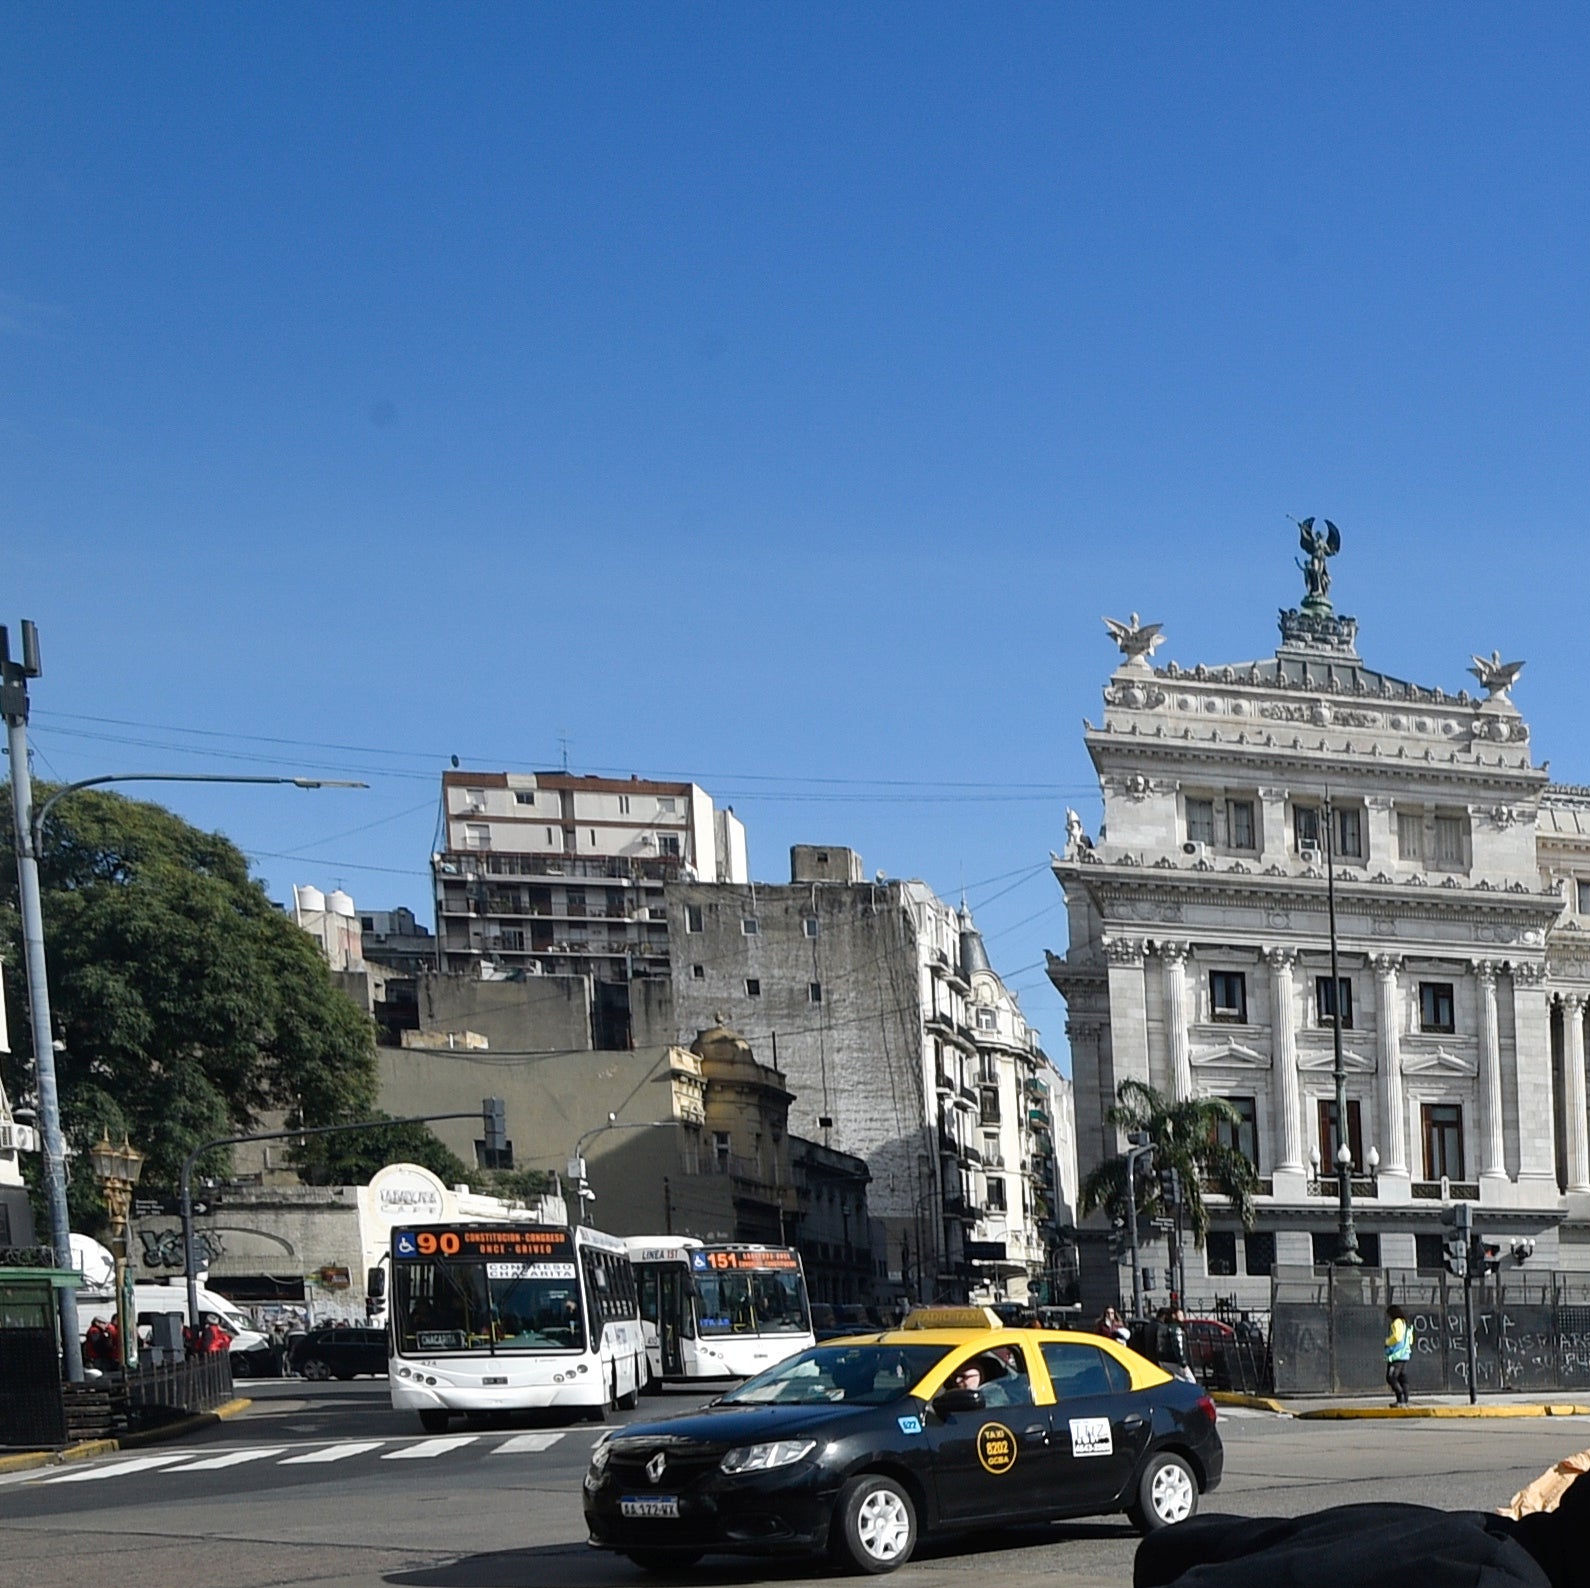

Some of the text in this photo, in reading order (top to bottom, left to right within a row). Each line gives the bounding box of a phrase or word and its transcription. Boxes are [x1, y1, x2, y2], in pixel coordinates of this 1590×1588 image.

[416, 1232, 460, 1255] 90
[667, 1249, 679, 1259] 151
[708, 1252, 737, 1269] 151
[489, 1263, 572, 1271] CONRESO
[984, 1430, 1005, 1440] TAXI
[986, 1441, 1009, 1456] 8202
